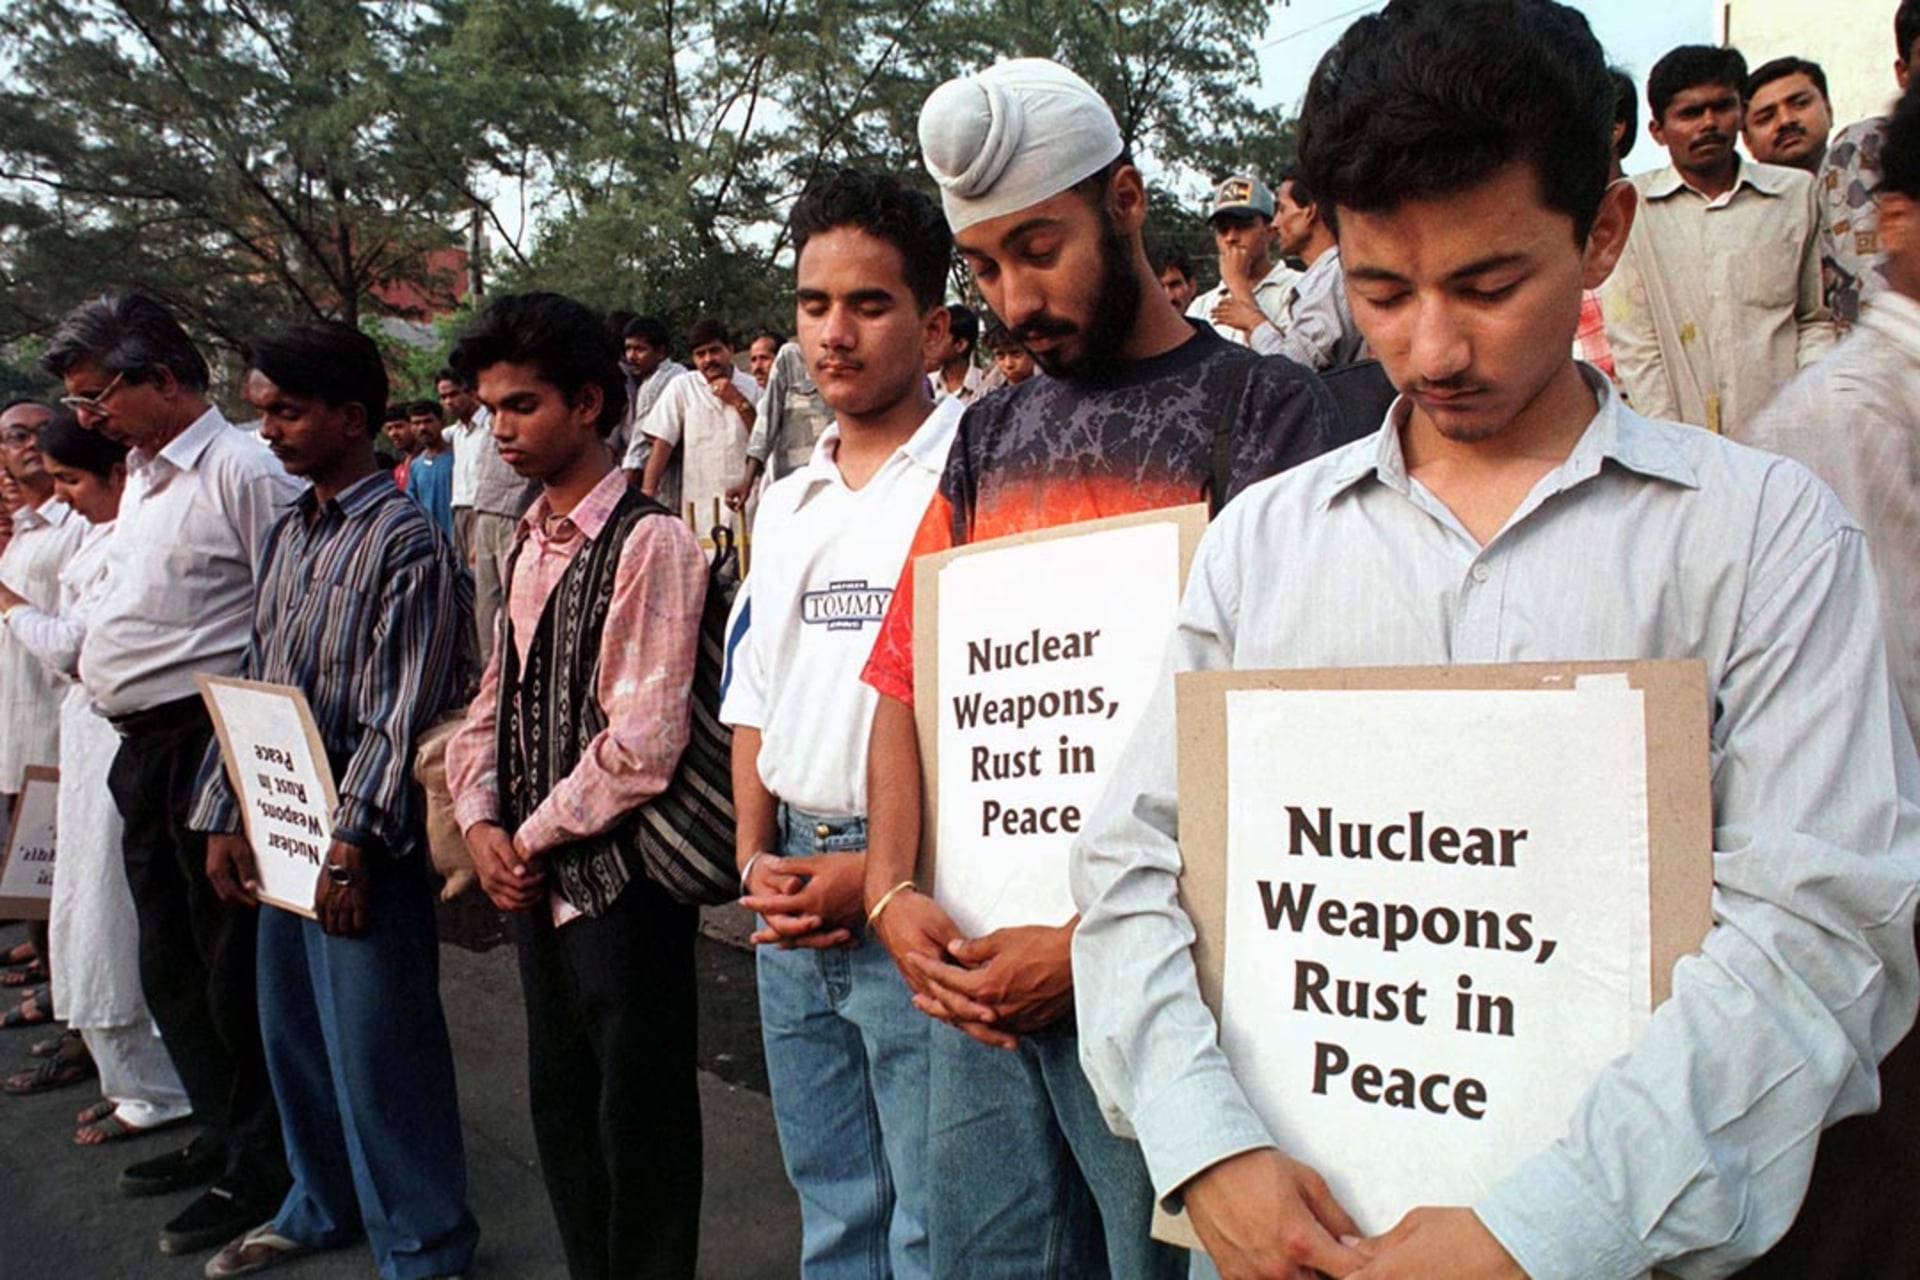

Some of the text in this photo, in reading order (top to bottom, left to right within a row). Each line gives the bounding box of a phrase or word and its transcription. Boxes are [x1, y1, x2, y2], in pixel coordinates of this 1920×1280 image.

[809, 594, 889, 618] TOMMY
[967, 628, 1101, 675] Nuclear
[953, 686, 1120, 730] Weapons,
[254, 744, 294, 772] Peace
[971, 734, 1096, 782] Rust in
[257, 773, 308, 804] Rust in
[256, 798, 324, 838] Weapons,
[981, 799, 1081, 837] Peace
[1284, 805, 1529, 868] Nuclear
[268, 832, 320, 866] Nuclear
[1256, 879, 1558, 964] Weapons,
[1293, 959, 1515, 1037] Rust in
[1312, 1040, 1488, 1121] Peace
